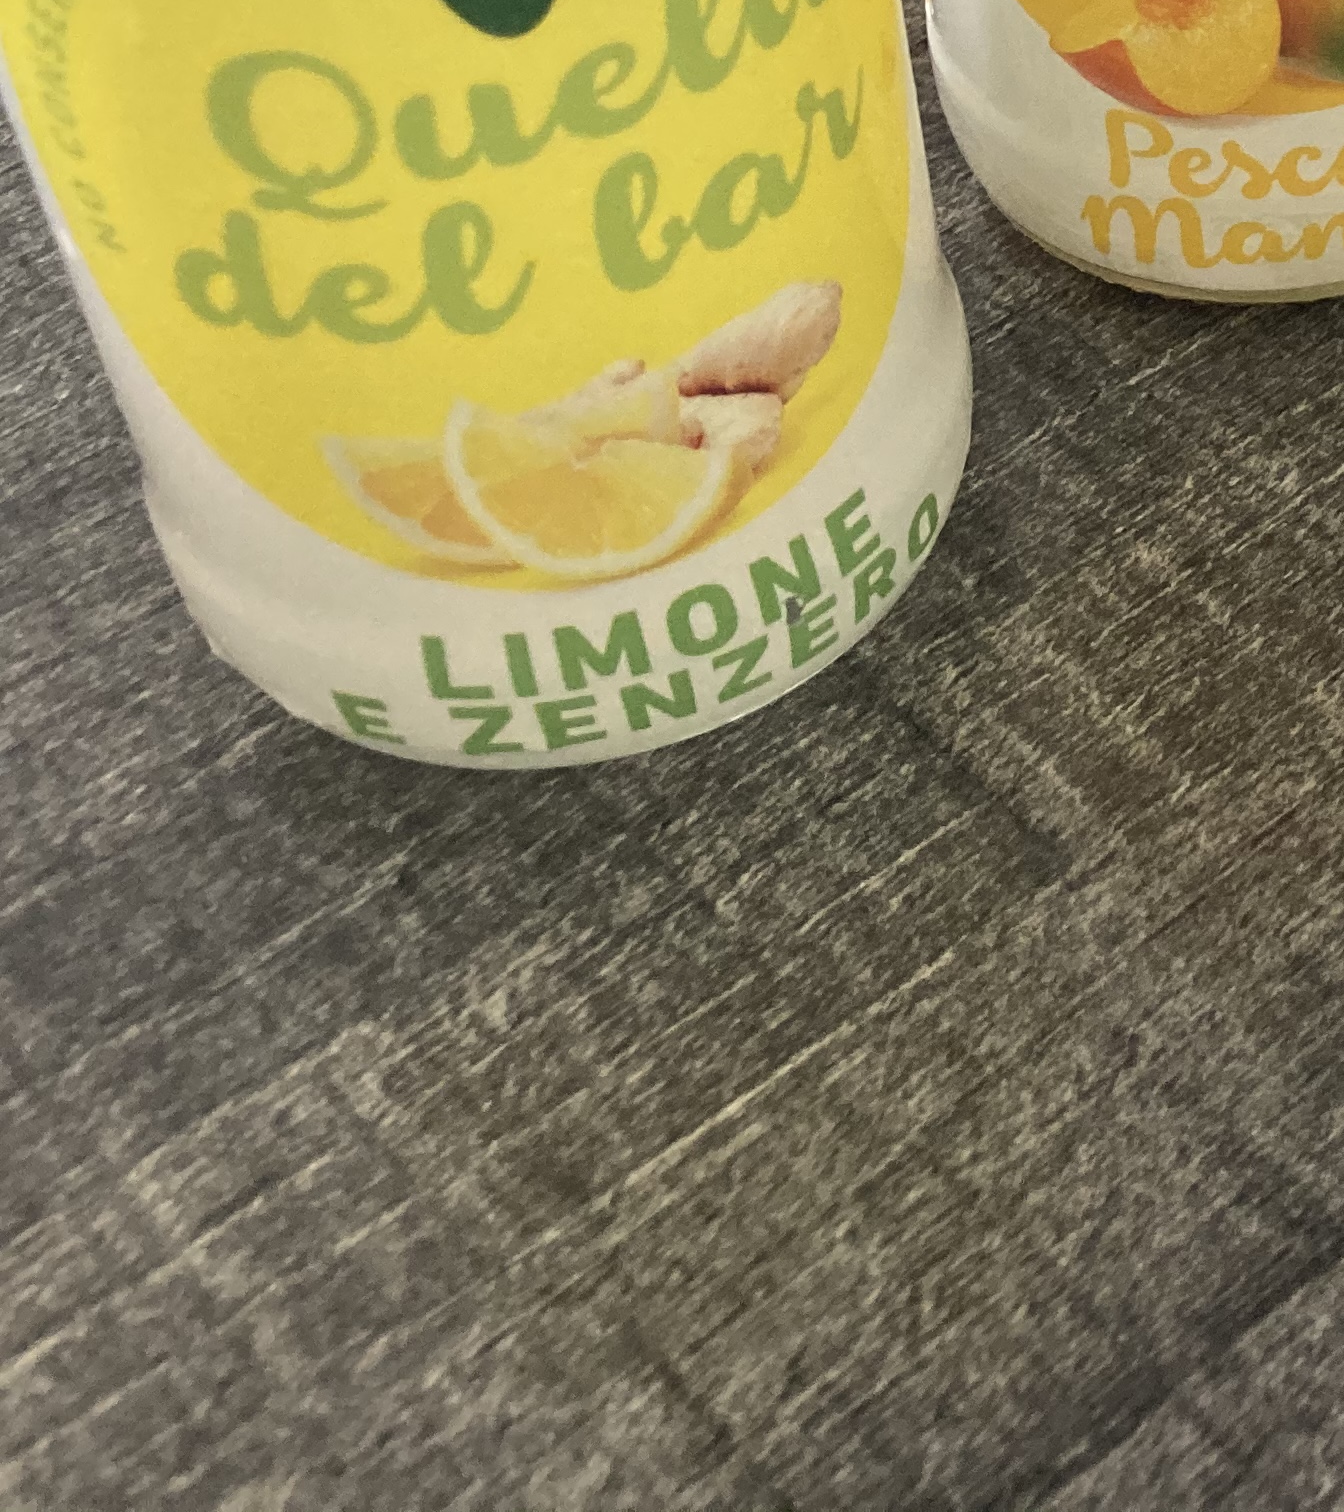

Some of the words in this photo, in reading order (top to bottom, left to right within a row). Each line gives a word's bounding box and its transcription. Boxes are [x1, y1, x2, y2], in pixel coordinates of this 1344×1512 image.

[174, 200, 536, 345] del
[591, 64, 865, 291] bar
[332, 690, 407, 744] E
[447, 493, 939, 756] ZENZERO
[420, 488, 881, 700] LIMONE
